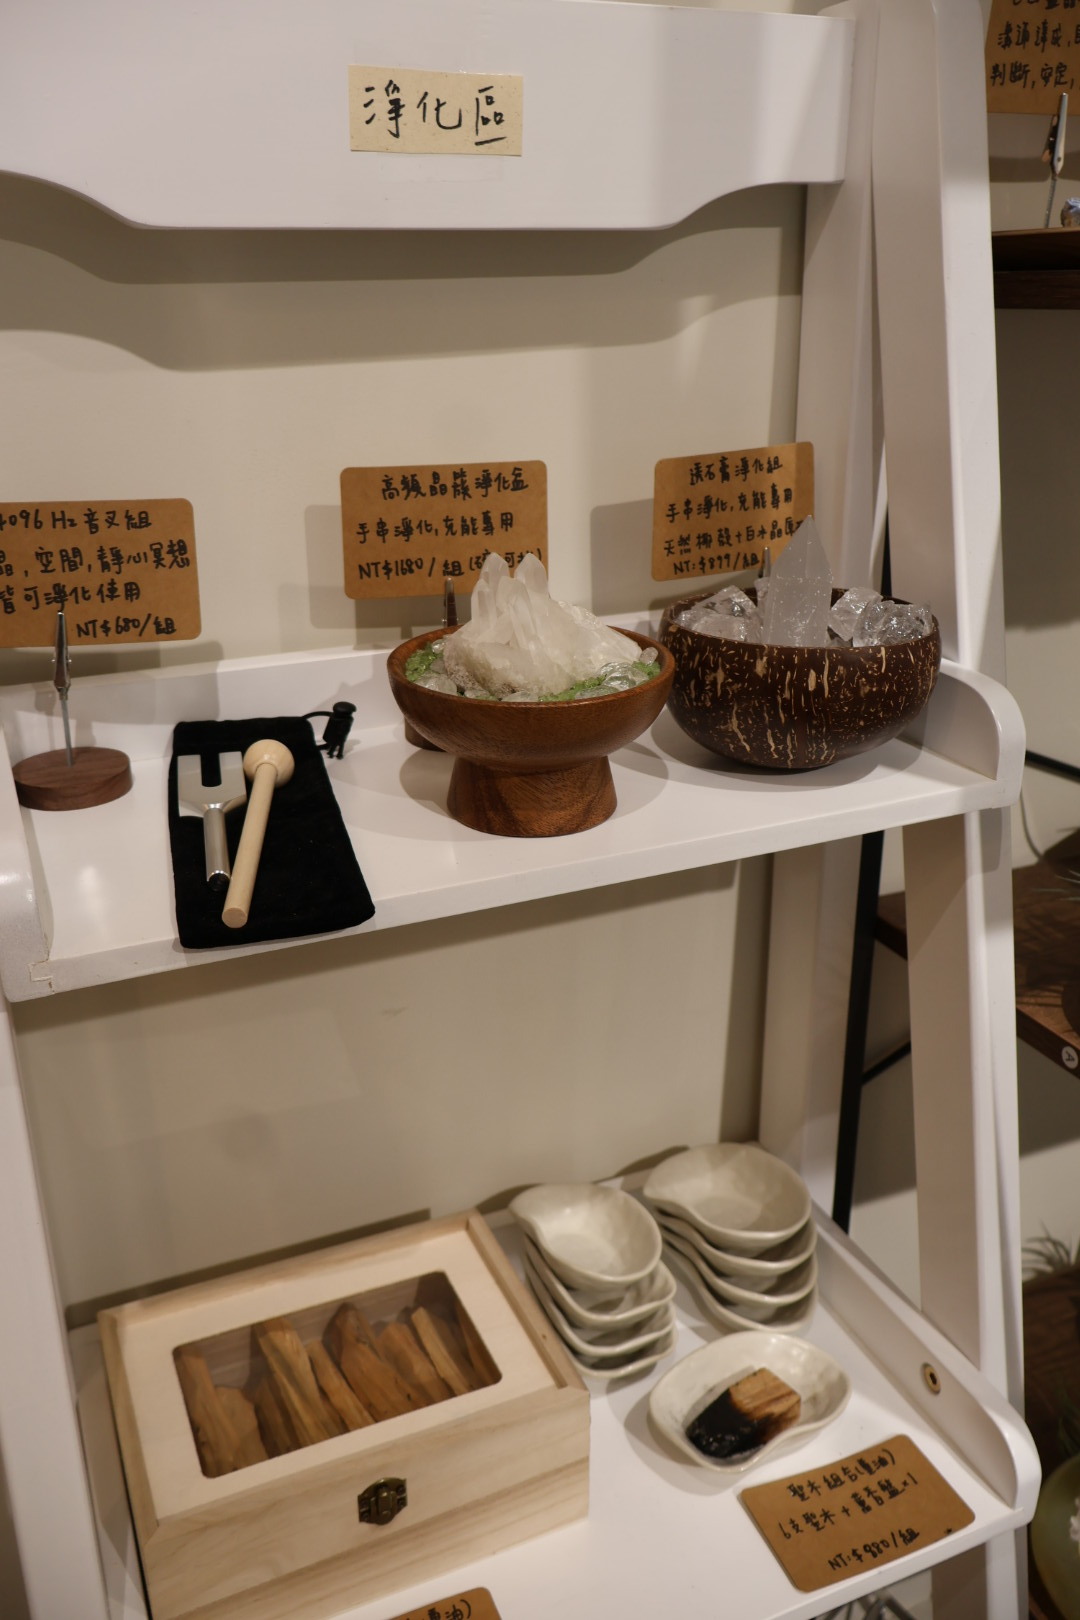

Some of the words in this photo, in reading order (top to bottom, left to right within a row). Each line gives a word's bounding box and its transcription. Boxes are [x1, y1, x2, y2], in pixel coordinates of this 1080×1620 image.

[363, 79, 508, 146] 淨化區
[84, 508, 152, 535] 音叉組
